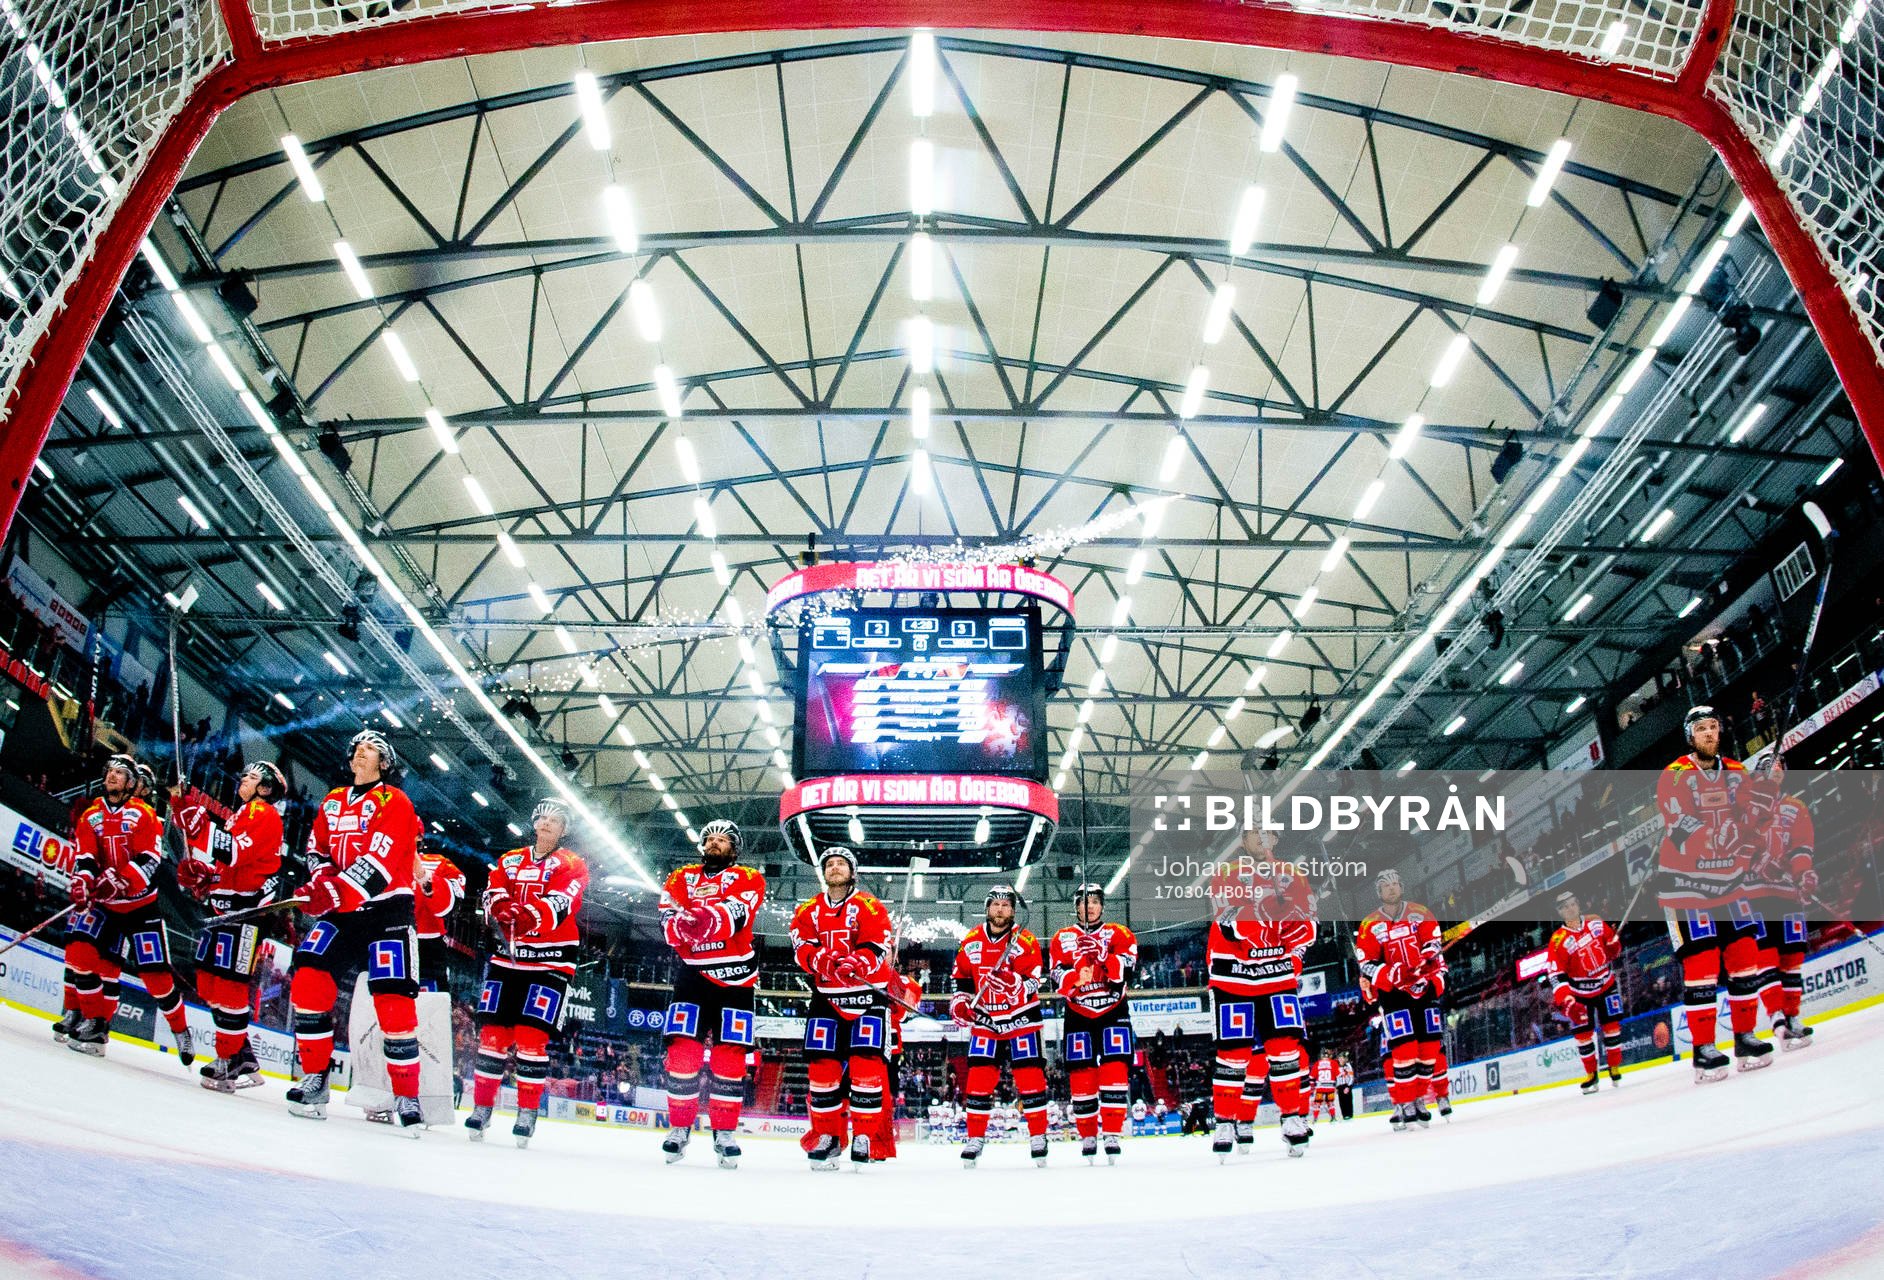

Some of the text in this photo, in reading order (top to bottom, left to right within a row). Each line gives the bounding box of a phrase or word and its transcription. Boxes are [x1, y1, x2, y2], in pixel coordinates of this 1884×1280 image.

[922, 569, 941, 588] VI
[943, 567, 984, 588] SOM
[801, 776, 1030, 808] DET ÄR VI SOM ÄR ÖREBRO
[11, 821, 77, 877] ELON
[368, 831, 394, 858] 85
[1250, 947, 1284, 958] ÖREBRO
[1133, 1001, 1197, 1013] Vintergatan
[615, 1109, 649, 1125] ELON
[773, 1125, 806, 1135] Nolato
